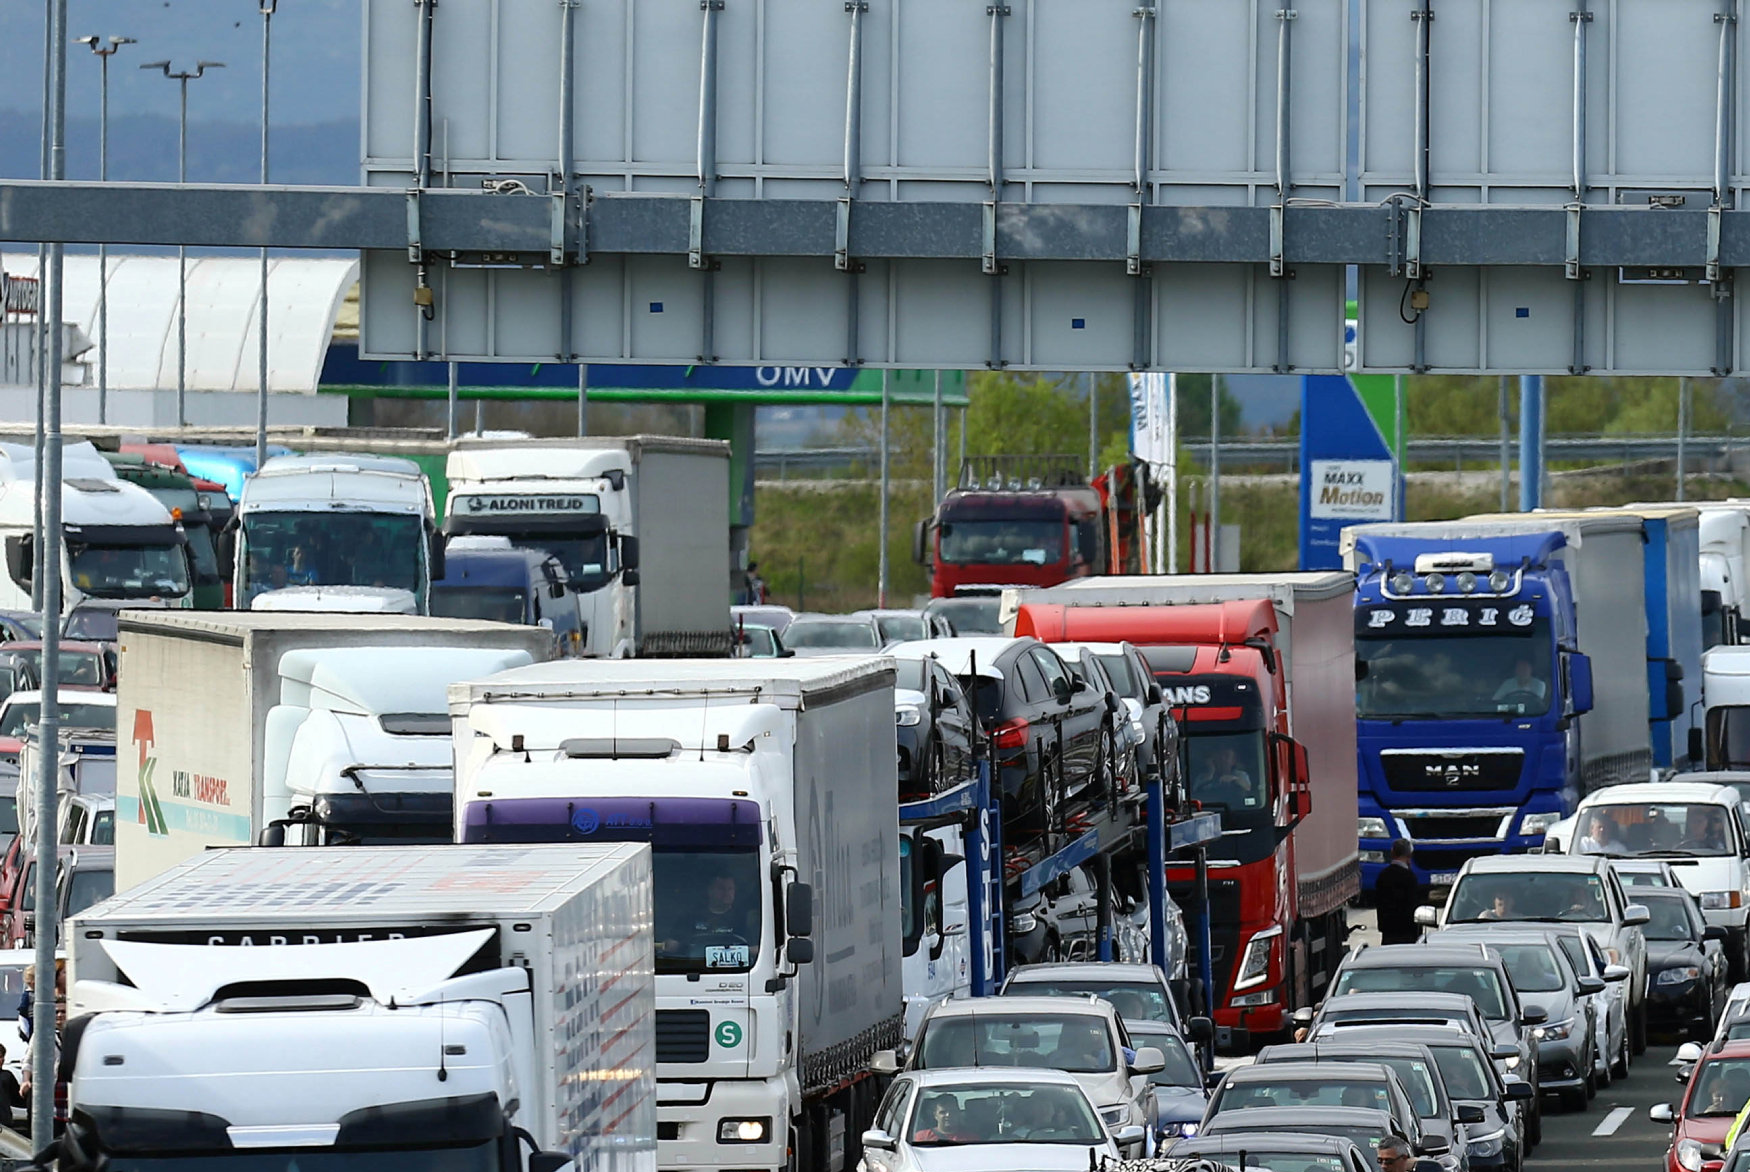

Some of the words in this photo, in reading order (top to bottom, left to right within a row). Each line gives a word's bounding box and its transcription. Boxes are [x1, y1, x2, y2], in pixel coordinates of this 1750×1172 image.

[756, 367, 836, 386] OMV
[1324, 472, 1366, 485] MAXX
[489, 499, 534, 510] ALONI
[538, 499, 583, 510] TREJD
[1319, 486, 1385, 507] Motion
[1368, 604, 1534, 628] PERIĆ
[1162, 685, 1211, 704] ANS
[1425, 765, 1480, 776] MAN
[713, 951, 742, 963] SALKO
[722, 1025, 736, 1044] S
